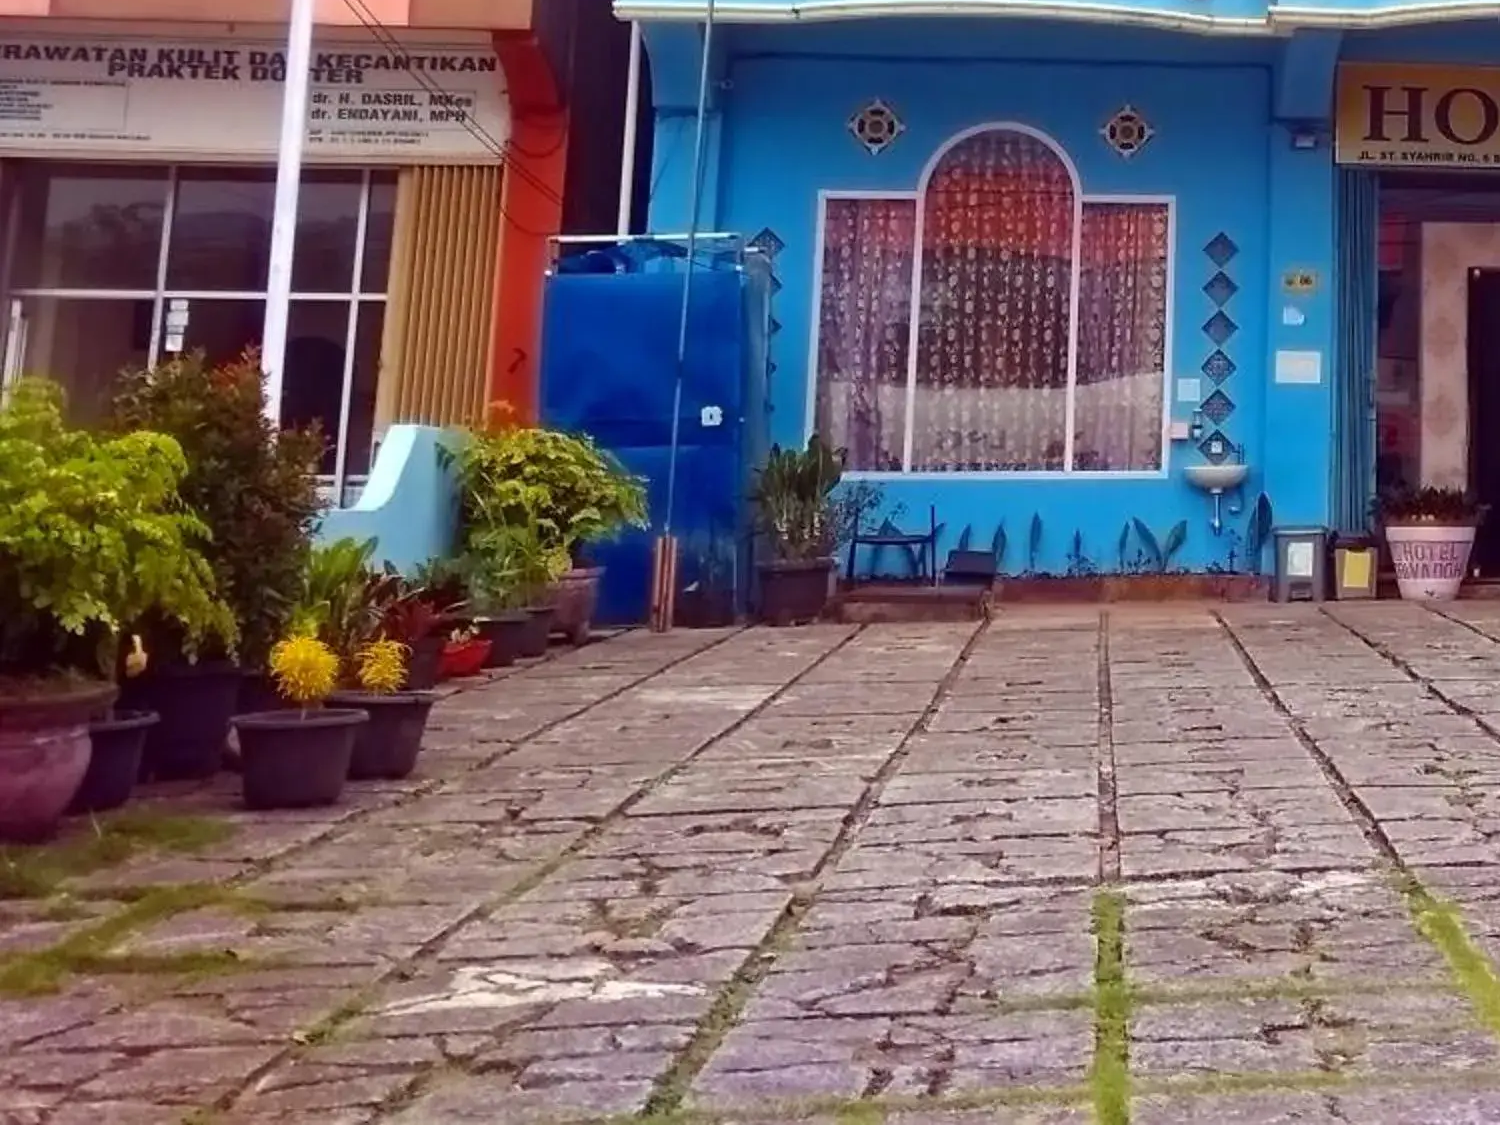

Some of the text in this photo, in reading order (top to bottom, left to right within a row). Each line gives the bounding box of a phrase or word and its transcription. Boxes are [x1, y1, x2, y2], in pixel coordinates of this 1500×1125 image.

[0, 44, 498, 72] RAWATAN KULIT DA KECANTIKAN
[107, 62, 364, 84] PRAKTEK DOTER
[312, 92, 332, 104] dr.
[311, 107, 332, 120] dr.
